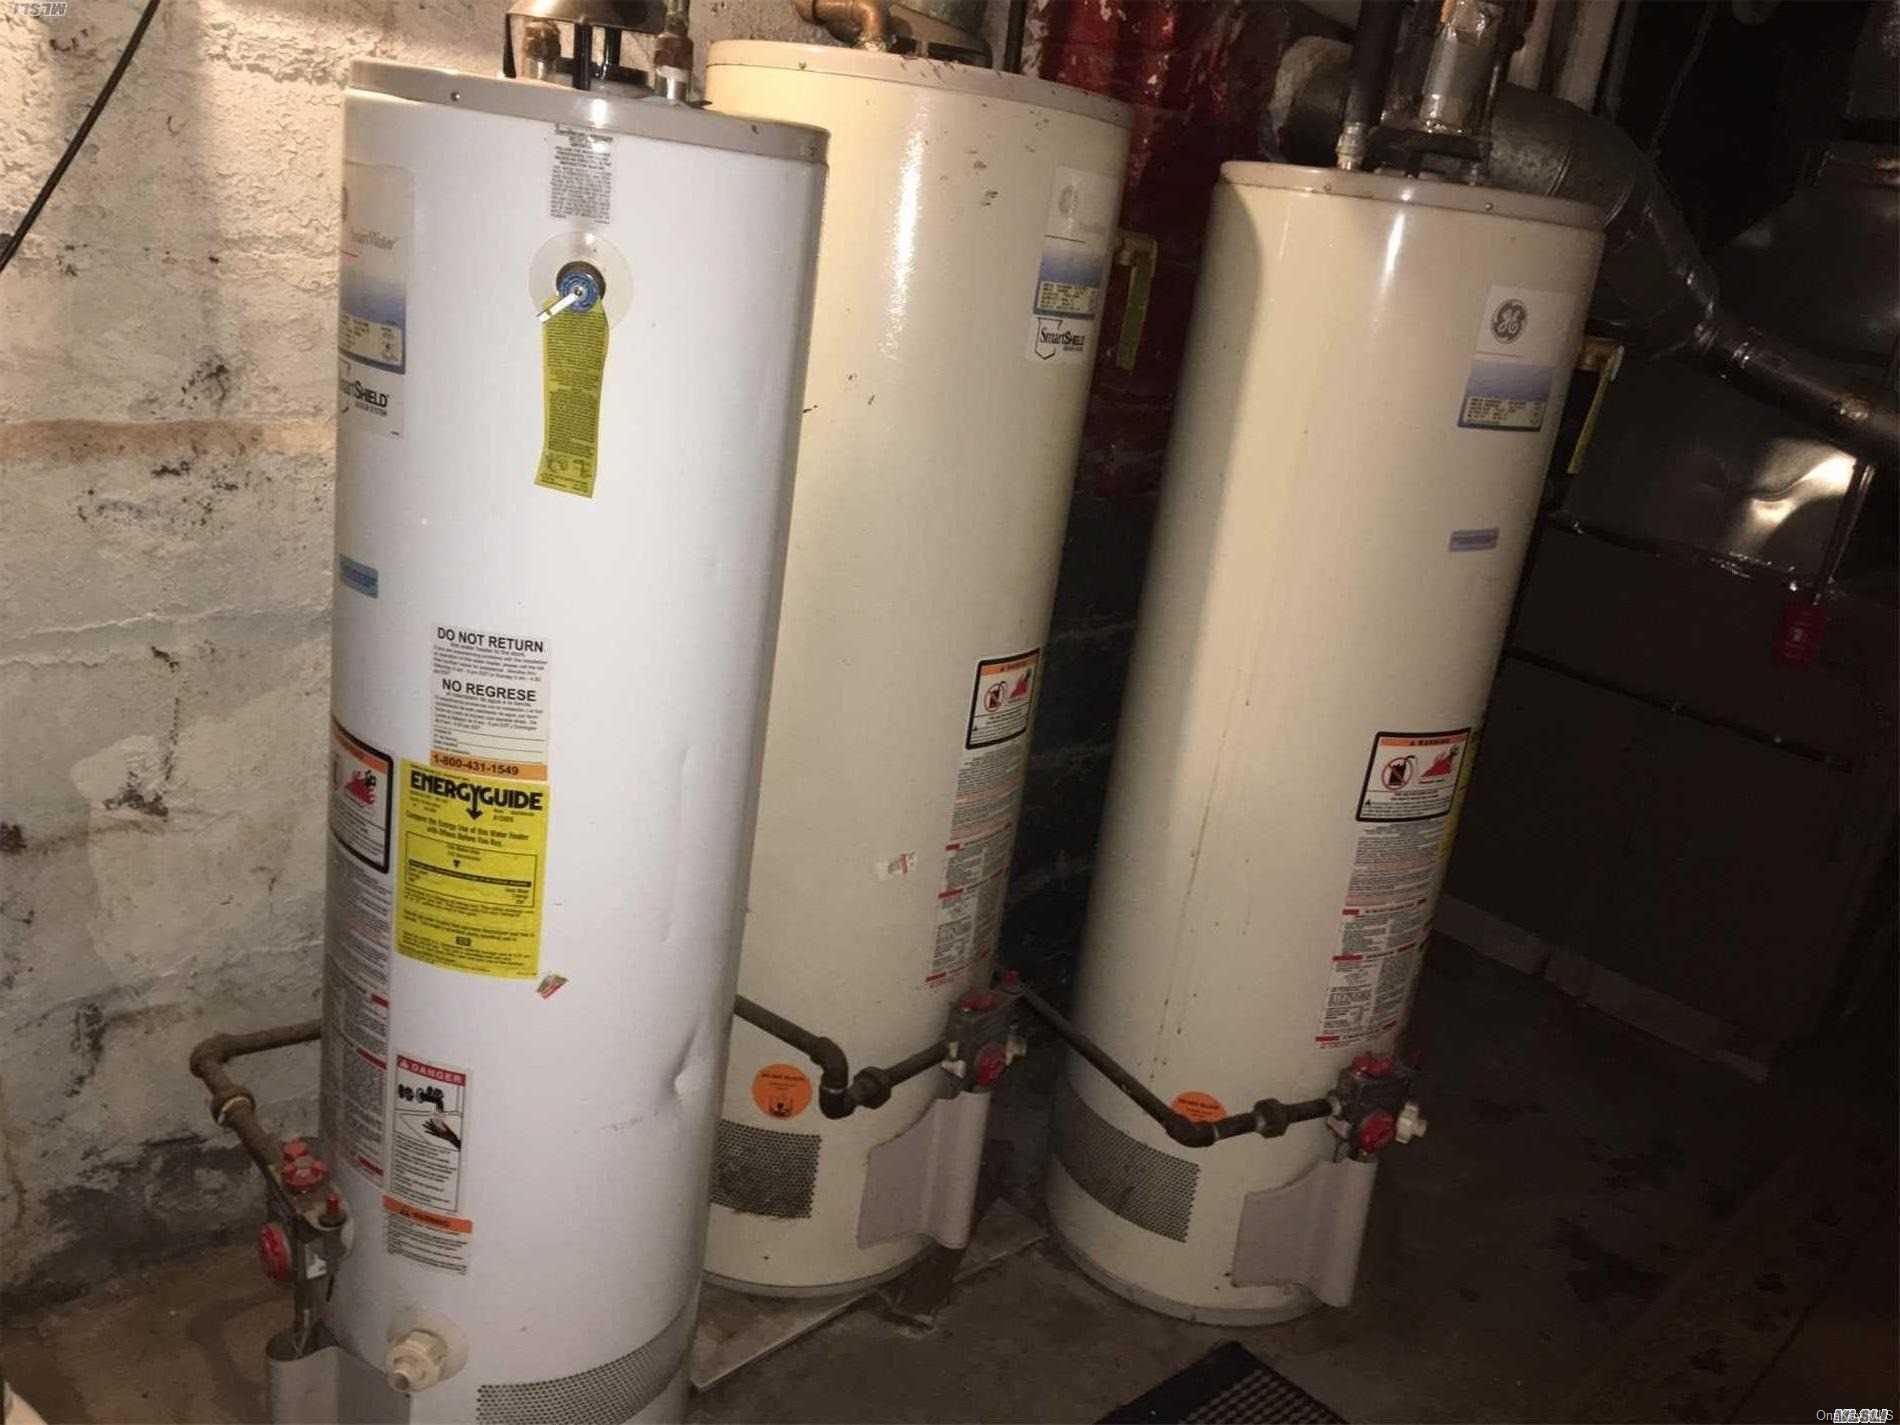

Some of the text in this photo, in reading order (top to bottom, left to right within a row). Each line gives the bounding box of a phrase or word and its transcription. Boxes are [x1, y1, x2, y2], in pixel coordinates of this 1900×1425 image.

[437, 626, 544, 653] DO NOT RETURN
[442, 678, 537, 702] NO REGRESE
[433, 753, 519, 776] 1-800-431-1549
[410, 770, 543, 811] ENERGYGUIDE
[411, 1062, 464, 1084] DANGER
